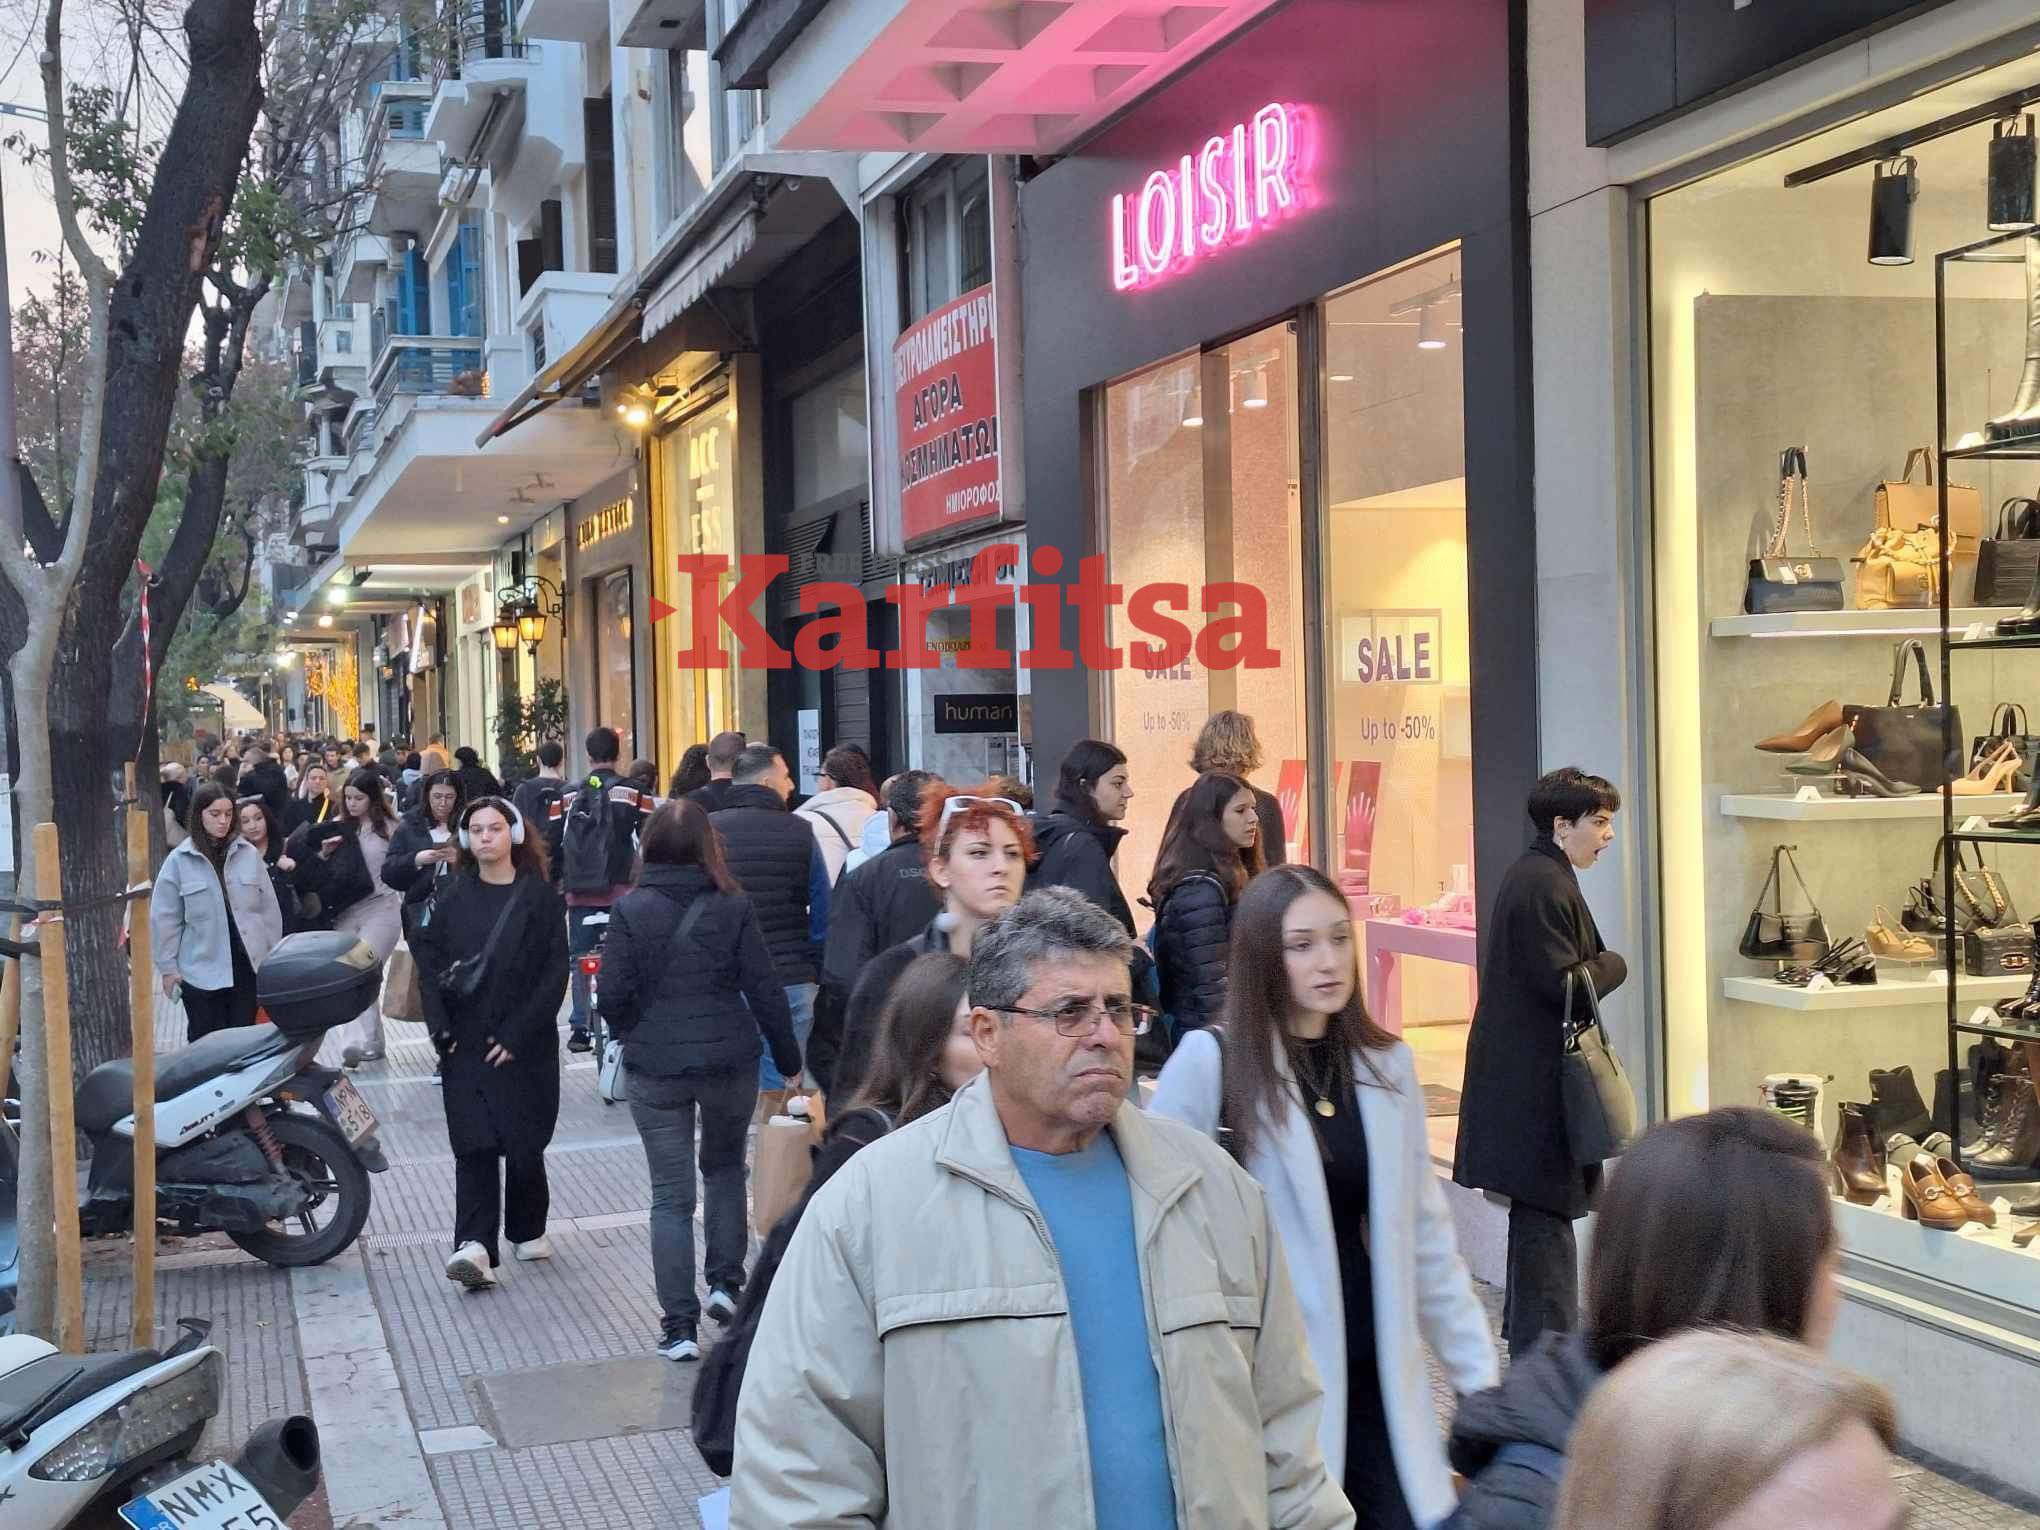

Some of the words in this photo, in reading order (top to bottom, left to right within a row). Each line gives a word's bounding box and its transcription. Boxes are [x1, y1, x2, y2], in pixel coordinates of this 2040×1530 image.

[1112, 102, 1291, 290] LOISIR
[914, 371, 963, 431] ΑΓΟΡΑ
[1358, 632, 1431, 683] SALE
[944, 701, 1014, 722] human
[1143, 711, 1155, 736] Up
[1157, 711, 1167, 730] to
[1361, 716, 1379, 744] Up
[1383, 716, 1396, 740] to
[1400, 714, 1435, 740] -50%
